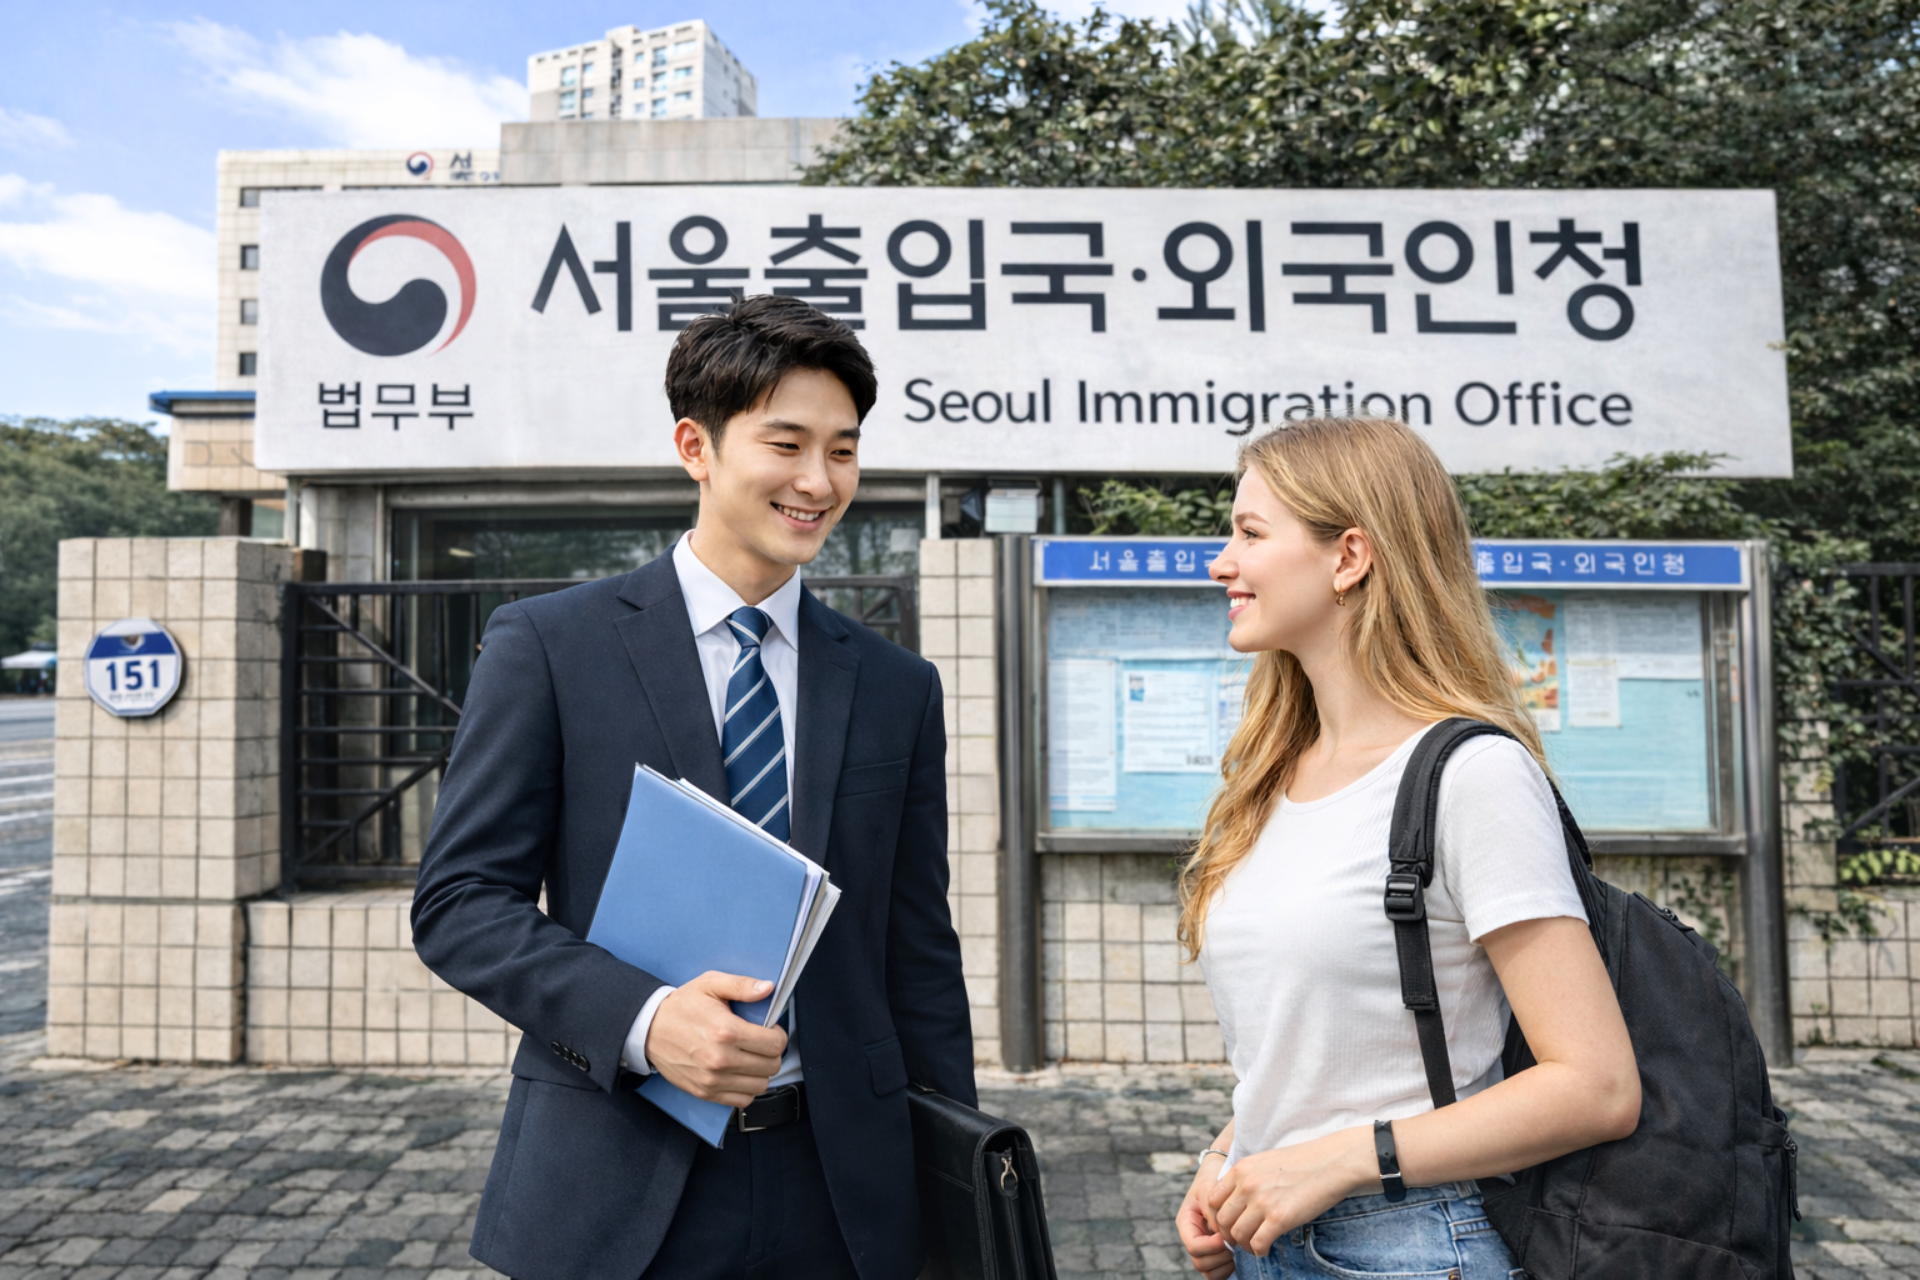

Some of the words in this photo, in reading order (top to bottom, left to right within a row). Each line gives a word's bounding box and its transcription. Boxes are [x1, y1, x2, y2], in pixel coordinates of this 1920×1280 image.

[531, 214, 1641, 342] 서울출입국·외국인청
[319, 382, 474, 431] 법무부
[905, 379, 1051, 424] Seoul
[1079, 380, 1432, 436] Immigration
[1456, 381, 1633, 427] Office
[106, 659, 160, 691] 151
